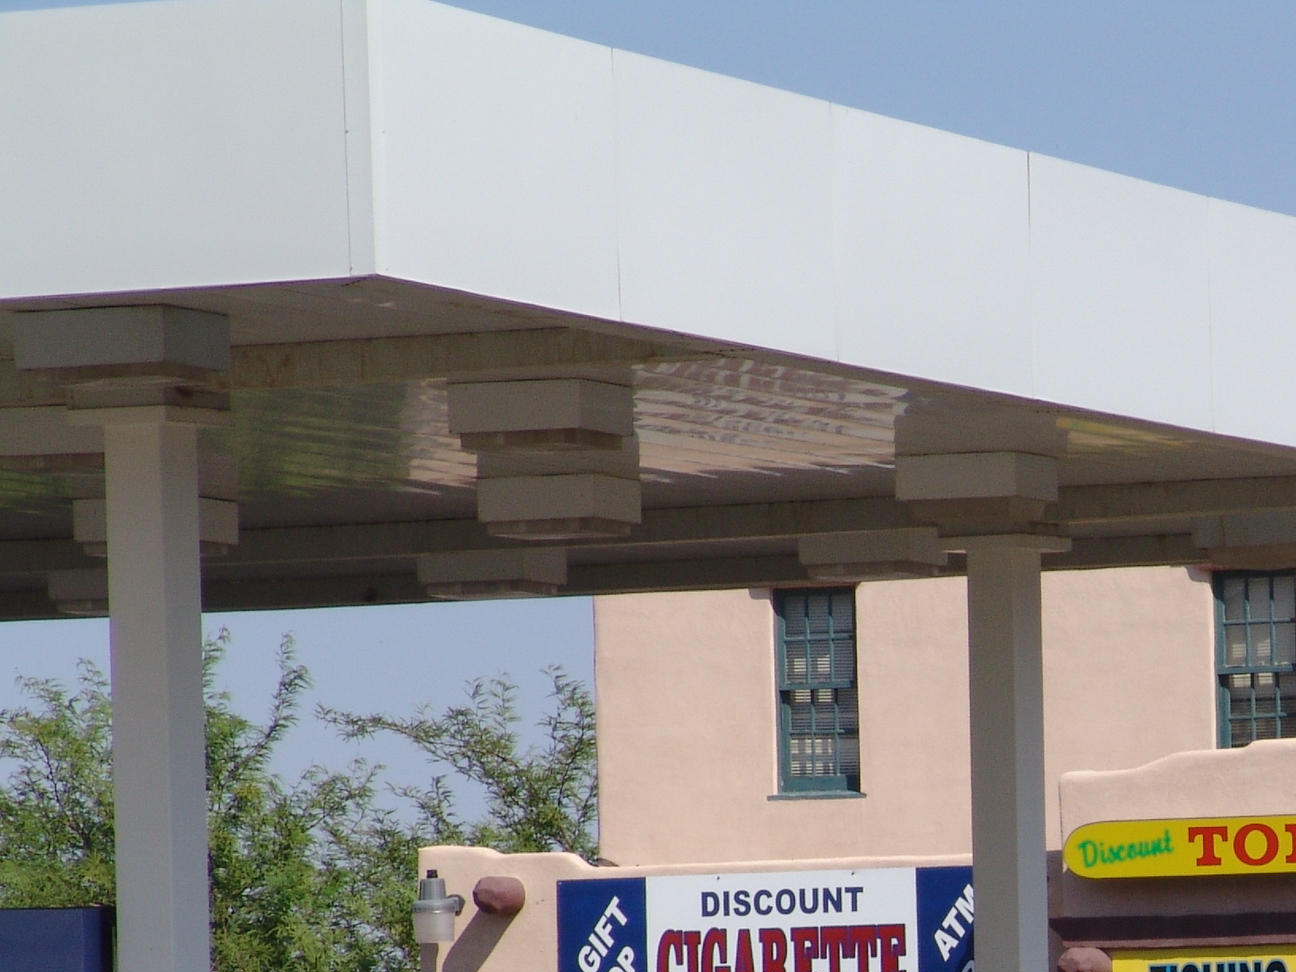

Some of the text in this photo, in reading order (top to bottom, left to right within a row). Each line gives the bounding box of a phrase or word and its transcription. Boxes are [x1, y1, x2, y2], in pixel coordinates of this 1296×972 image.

[1077, 829, 1173, 869] Discount
[701, 886, 864, 917] DISCOUNT
[934, 883, 974, 962] ATM
